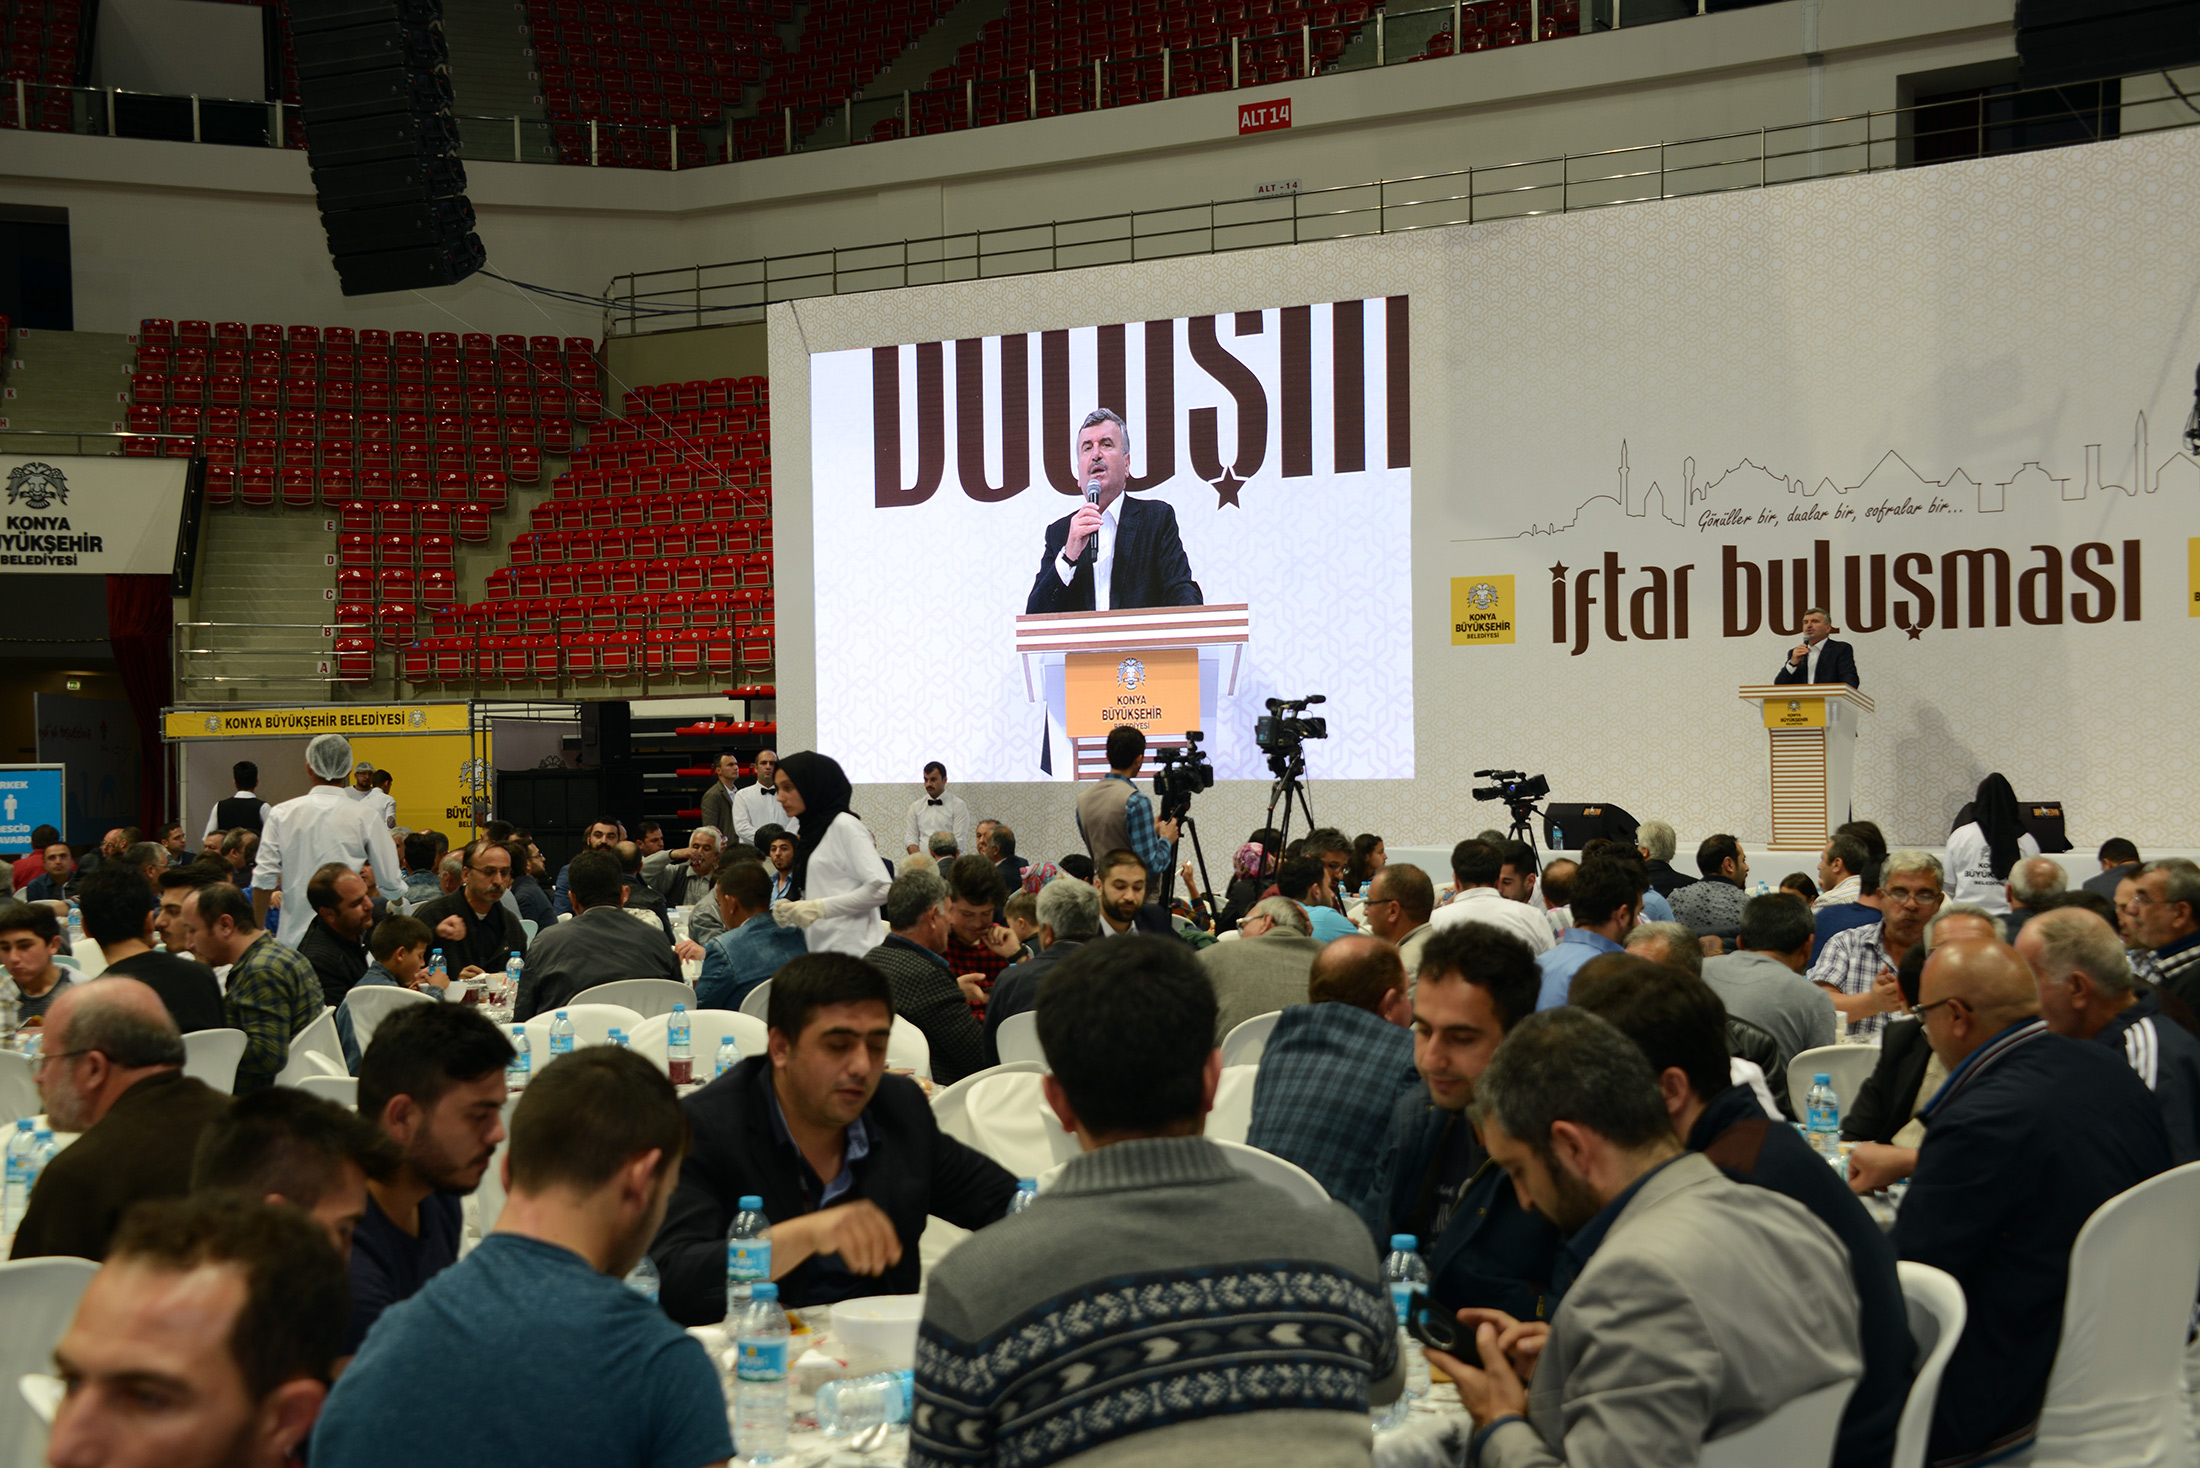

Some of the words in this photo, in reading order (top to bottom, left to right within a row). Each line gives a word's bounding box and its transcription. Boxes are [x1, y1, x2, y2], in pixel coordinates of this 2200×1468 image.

[1241, 108, 1267, 128] ALT
[1270, 105, 1289, 124] 14
[1258, 184, 1276, 194] ALT
[18, 329, 28, 338] M
[128, 334, 137, 344] M
[124, 365, 131, 374] L
[7, 388, 14, 398] K
[120, 393, 126, 402] K
[115, 422, 122, 432] H
[1698, 508, 1752, 533] Gönüller
[1757, 508, 1779, 527] bir,
[1786, 503, 1829, 522] dualar
[1834, 502, 1857, 522] bir,
[1864, 496, 1923, 524] sofralar
[1928, 496, 1963, 514] bir...
[6, 516, 71, 530] KONYA
[326, 521, 333, 530] E
[0, 531, 103, 554] YÜKŞEHİR
[0, 553, 78, 566] BELEDİYESİ
[327, 555, 334, 565] D
[326, 590, 333, 600] C
[1548, 551, 1695, 656] iftar
[1722, 538, 2141, 641] buluşması
[1469, 613, 1496, 622] KONYA
[1456, 620, 1510, 632] BÜYÜKŞEHİR
[324, 627, 332, 636] B
[1467, 632, 1500, 640] BELEDİYESİ
[320, 662, 328, 673] A
[1116, 695, 1147, 706] KONYA
[1102, 705, 1162, 721] BÜYÜKŞEHİR
[225, 717, 262, 730] KONYA
[265, 712, 337, 730] BÜYÜKŞEHİR
[340, 710, 405, 726] BELEDİYESİ
[0, 780, 29, 789] RKEK
[0, 822, 31, 832] ESCİD
